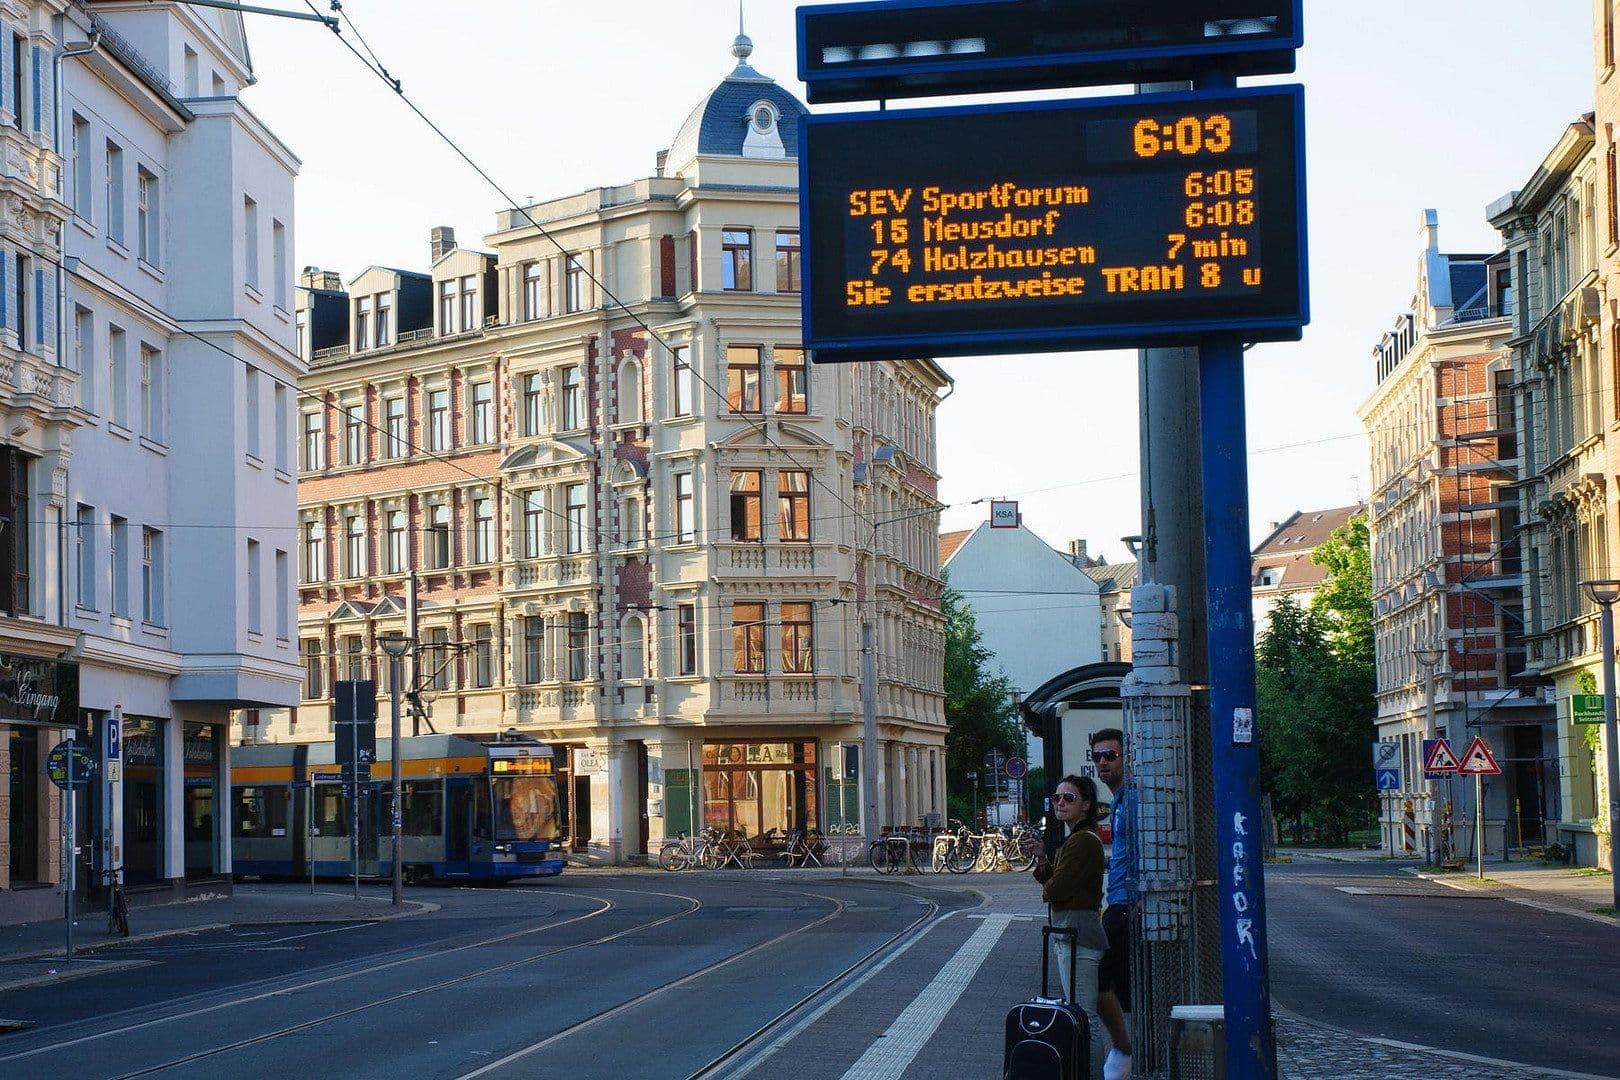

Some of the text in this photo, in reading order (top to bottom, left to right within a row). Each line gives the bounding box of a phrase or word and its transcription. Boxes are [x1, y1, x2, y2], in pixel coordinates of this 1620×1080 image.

[1133, 114, 1231, 157] 6:03
[849, 168, 1254, 216] SEV Sportforum 6:05
[871, 199, 1254, 244] 15 Meusdorf 6:08
[870, 233, 1247, 274] 74 Holzhausen 7 min
[846, 262, 1261, 306] Sie ersatzweise TRAM 8 u
[995, 510, 1013, 518] KSA
[14, 670, 59, 720] Eingang
[110, 724, 118, 754] P
[728, 746, 774, 762] OLEA
